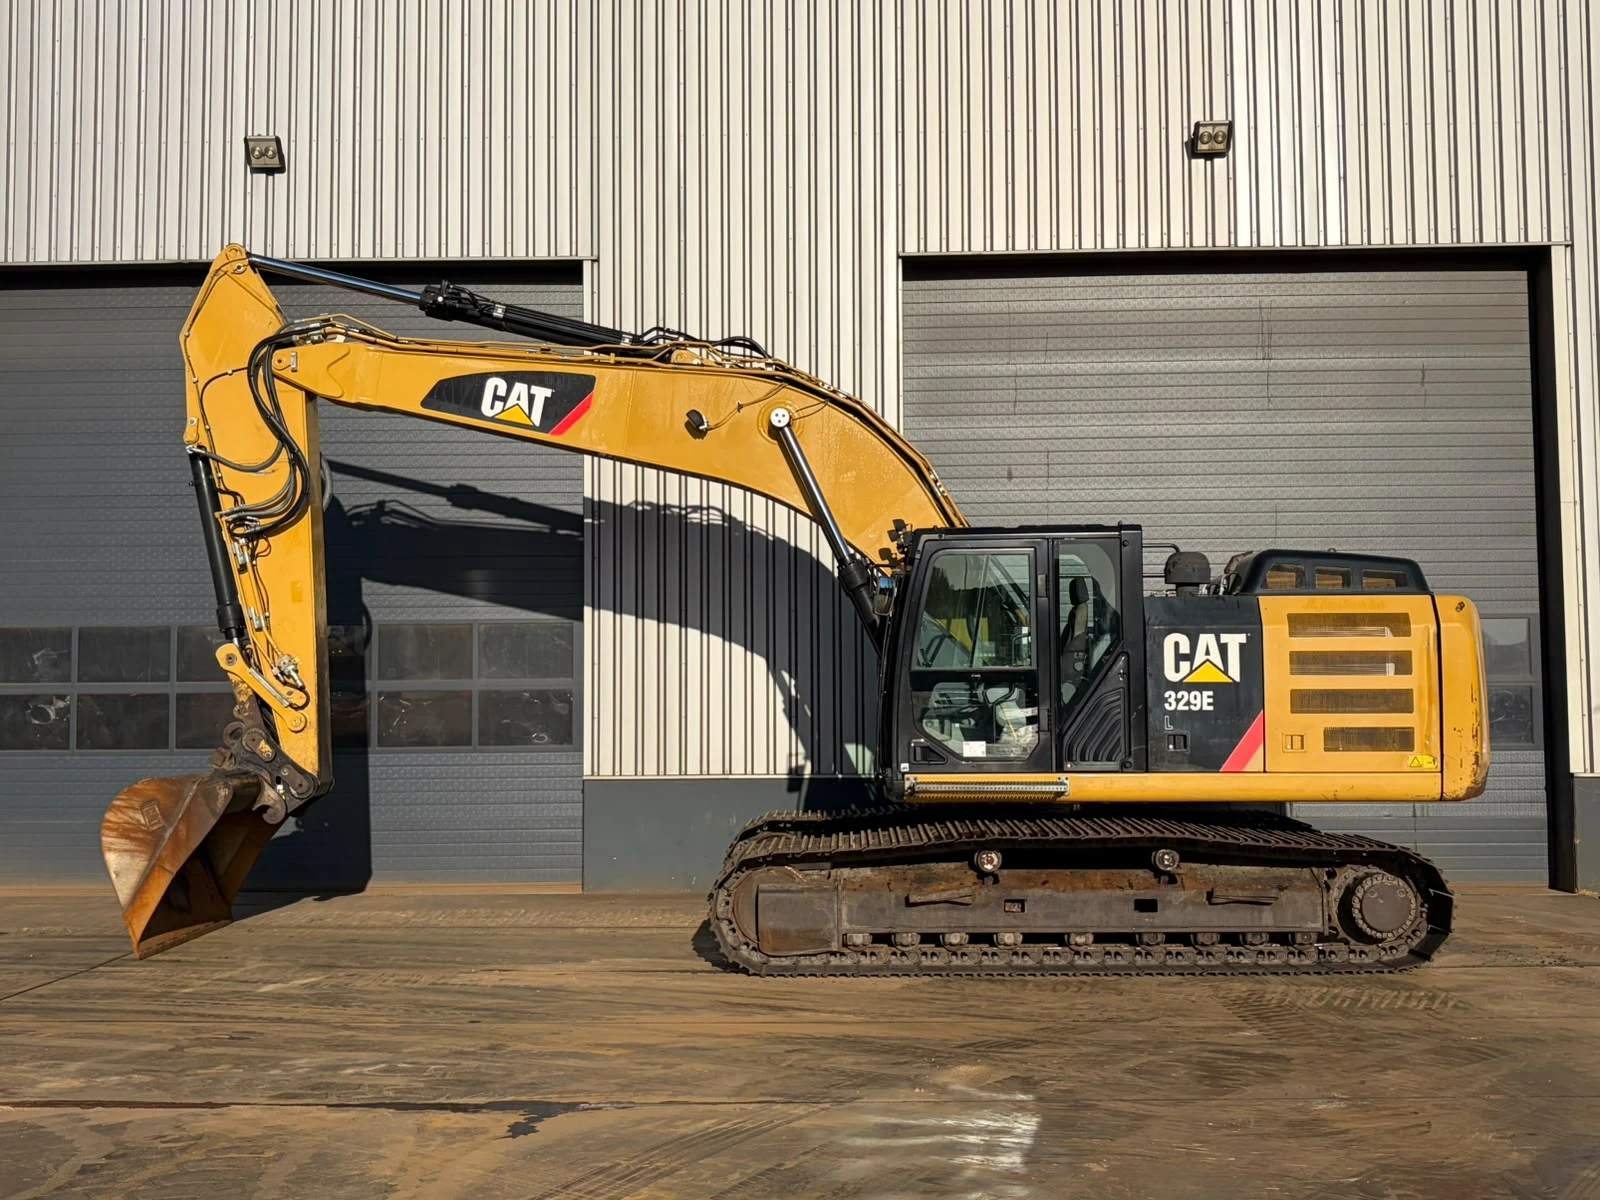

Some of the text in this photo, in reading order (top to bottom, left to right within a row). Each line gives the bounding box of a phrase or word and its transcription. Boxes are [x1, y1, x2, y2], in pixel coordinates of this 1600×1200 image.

[481, 377, 553, 427] CAT
[1163, 632, 1247, 683] CAT
[1164, 690, 1214, 711] 329E
